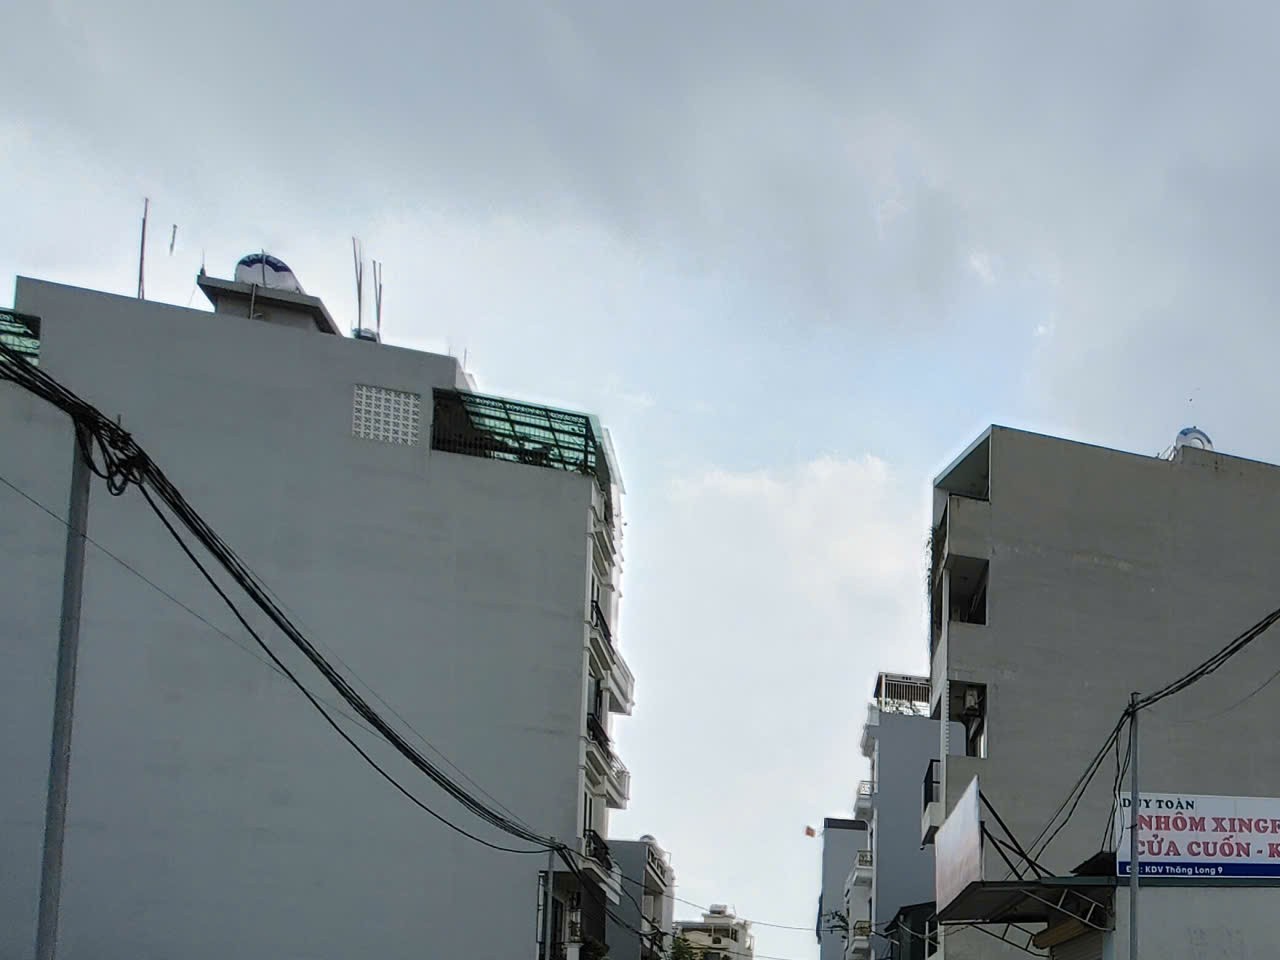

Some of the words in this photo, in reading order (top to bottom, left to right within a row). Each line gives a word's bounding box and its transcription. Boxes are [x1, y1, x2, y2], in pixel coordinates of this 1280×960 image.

[1138, 811, 1205, 832] NHÔM
[1187, 835, 1251, 858] CUỐN
[1195, 866, 1216, 875] Long
